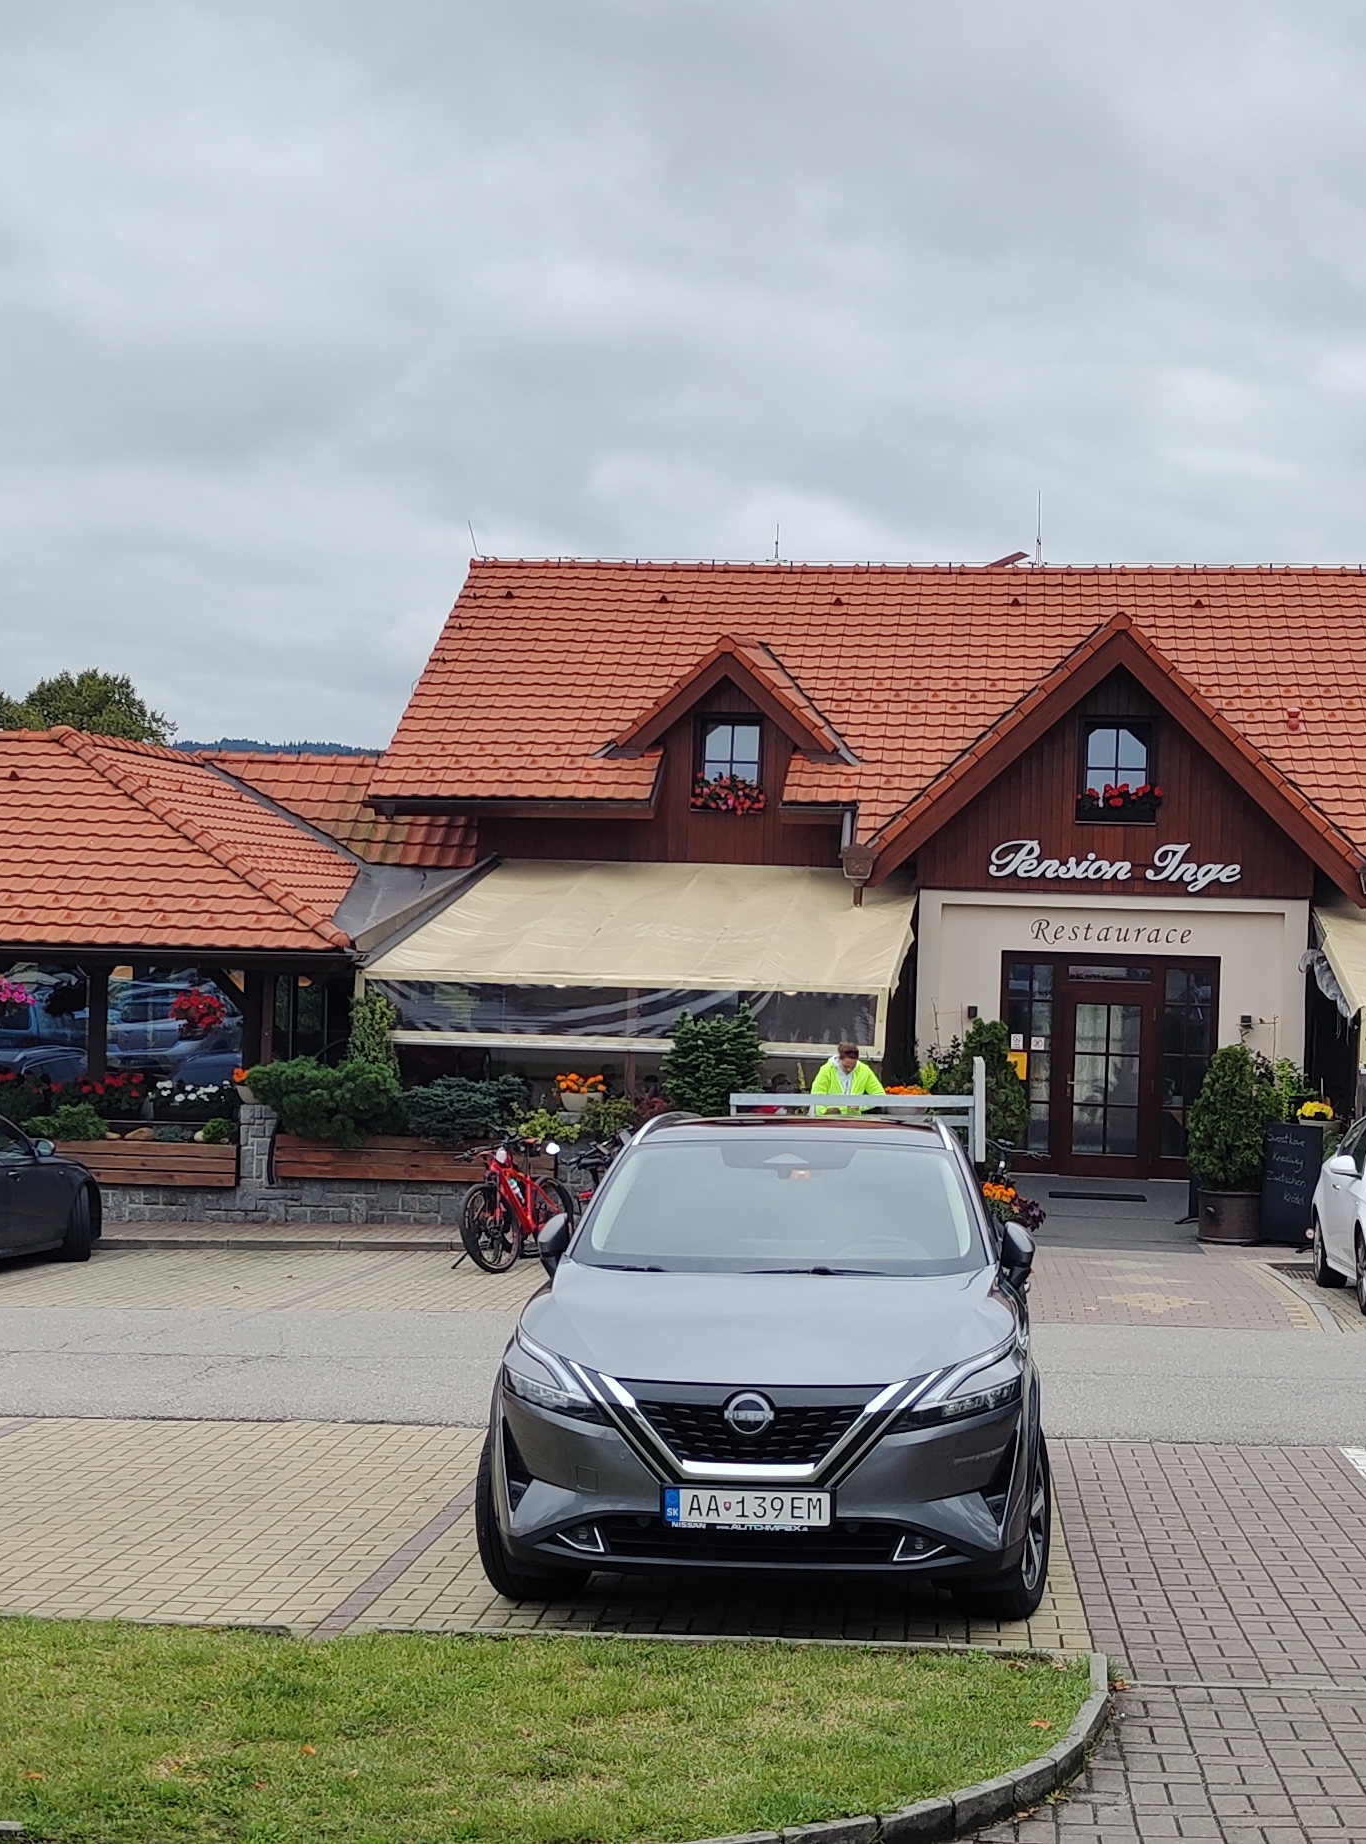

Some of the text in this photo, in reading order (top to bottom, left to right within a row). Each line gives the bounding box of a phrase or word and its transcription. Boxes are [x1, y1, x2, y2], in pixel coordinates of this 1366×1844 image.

[988, 838, 1242, 893] Pension Inge
[1030, 918, 1193, 946] Restaurace
[725, 1411, 774, 1420] NISSAN
[665, 1507, 679, 1517] SK
[688, 1494, 721, 1518] AA
[670, 1521, 707, 1530] NISSAN
